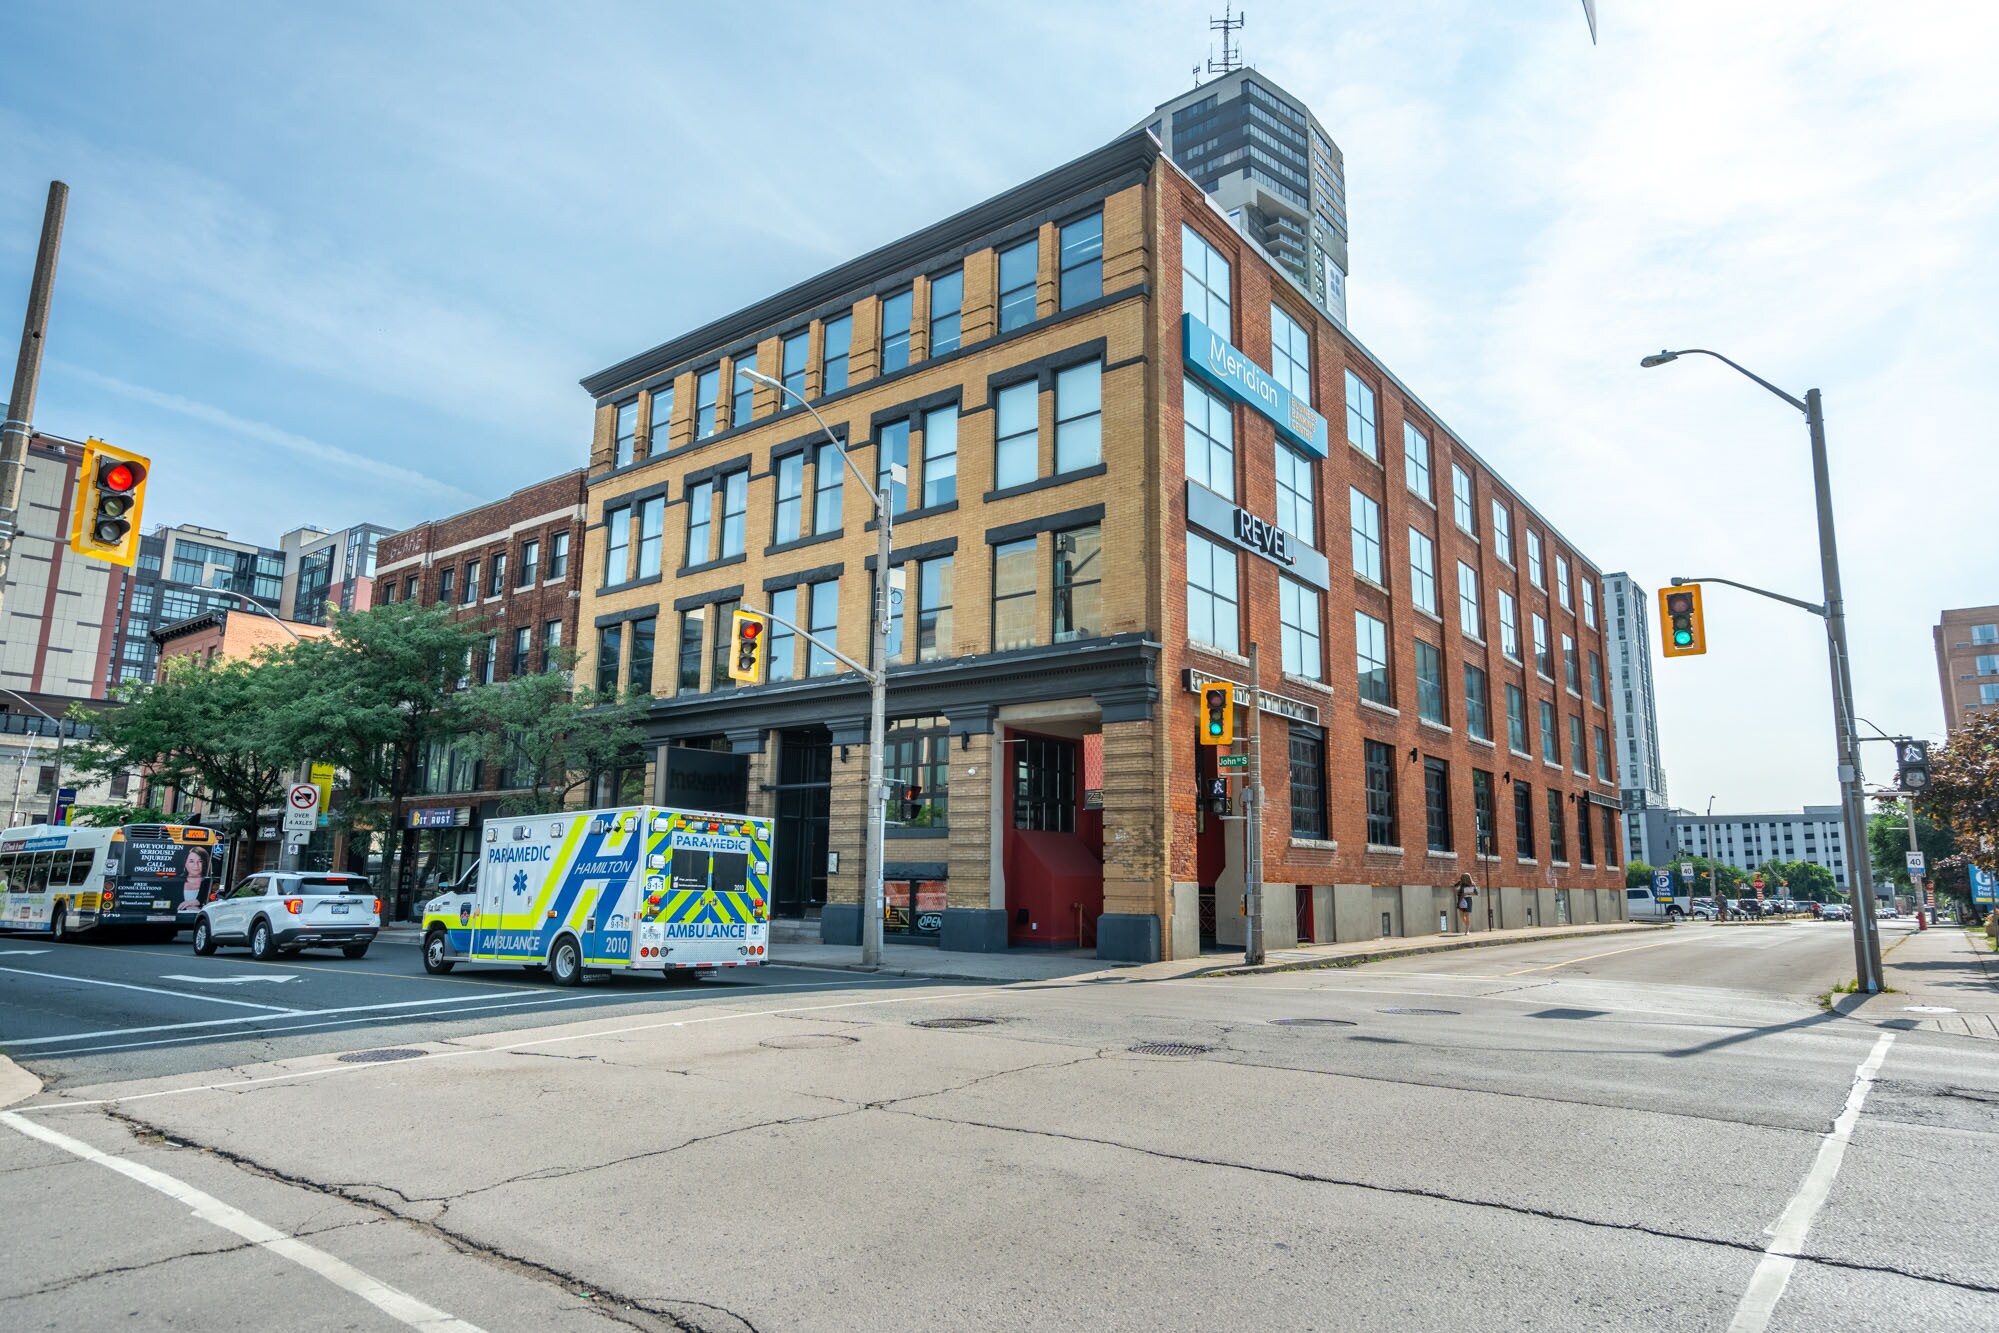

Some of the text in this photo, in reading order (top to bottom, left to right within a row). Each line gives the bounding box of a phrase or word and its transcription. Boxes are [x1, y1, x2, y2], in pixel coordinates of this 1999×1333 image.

[1210, 334, 1278, 409] Meridian
[1291, 397, 1317, 424] BUSINESS
[1291, 408, 1316, 433] BANKING
[1291, 420, 1313, 442] CENTRE
[1242, 756, 1247, 764] S
[676, 835, 747, 851] PARAMEDIC
[489, 845, 551, 864] PARAMEDIC
[574, 861, 633, 875] HAMILTON
[920, 916, 942, 928] OPEN
[666, 924, 745, 938] AMBULANCE
[483, 935, 540, 951] AMBULANCE
[606, 937, 628, 954] 2010
